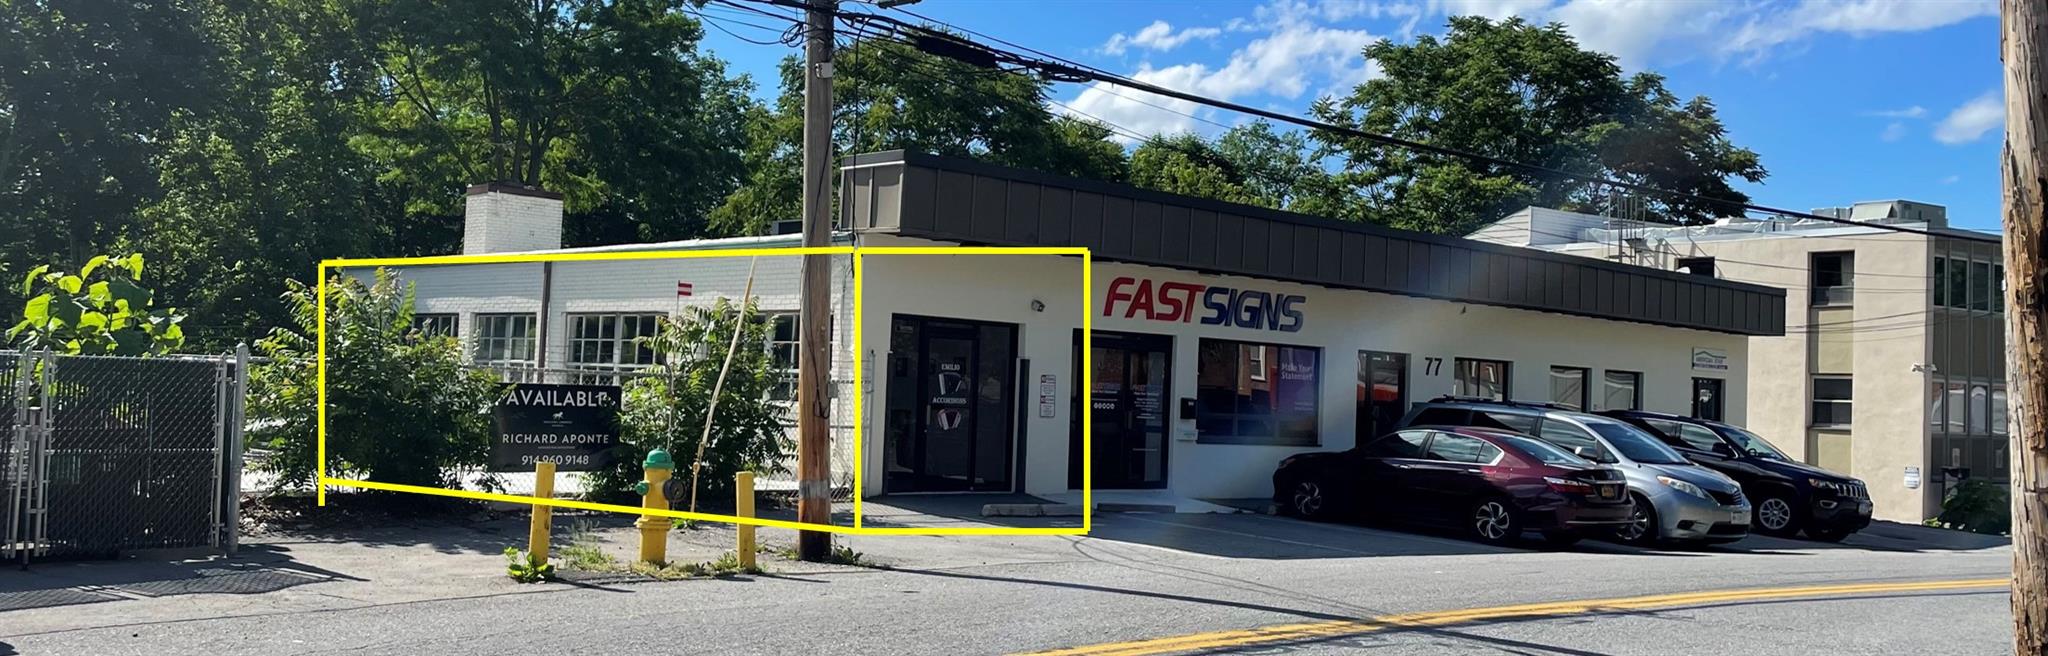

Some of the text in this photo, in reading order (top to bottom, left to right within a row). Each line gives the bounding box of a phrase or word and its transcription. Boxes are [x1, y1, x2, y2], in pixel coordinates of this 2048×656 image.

[1103, 277, 1306, 332] FASTSIGNS
[1424, 357, 1443, 376] 77
[502, 434, 609, 444] RICHARD APONTE
[521, 455, 589, 465] 914 960 9148
